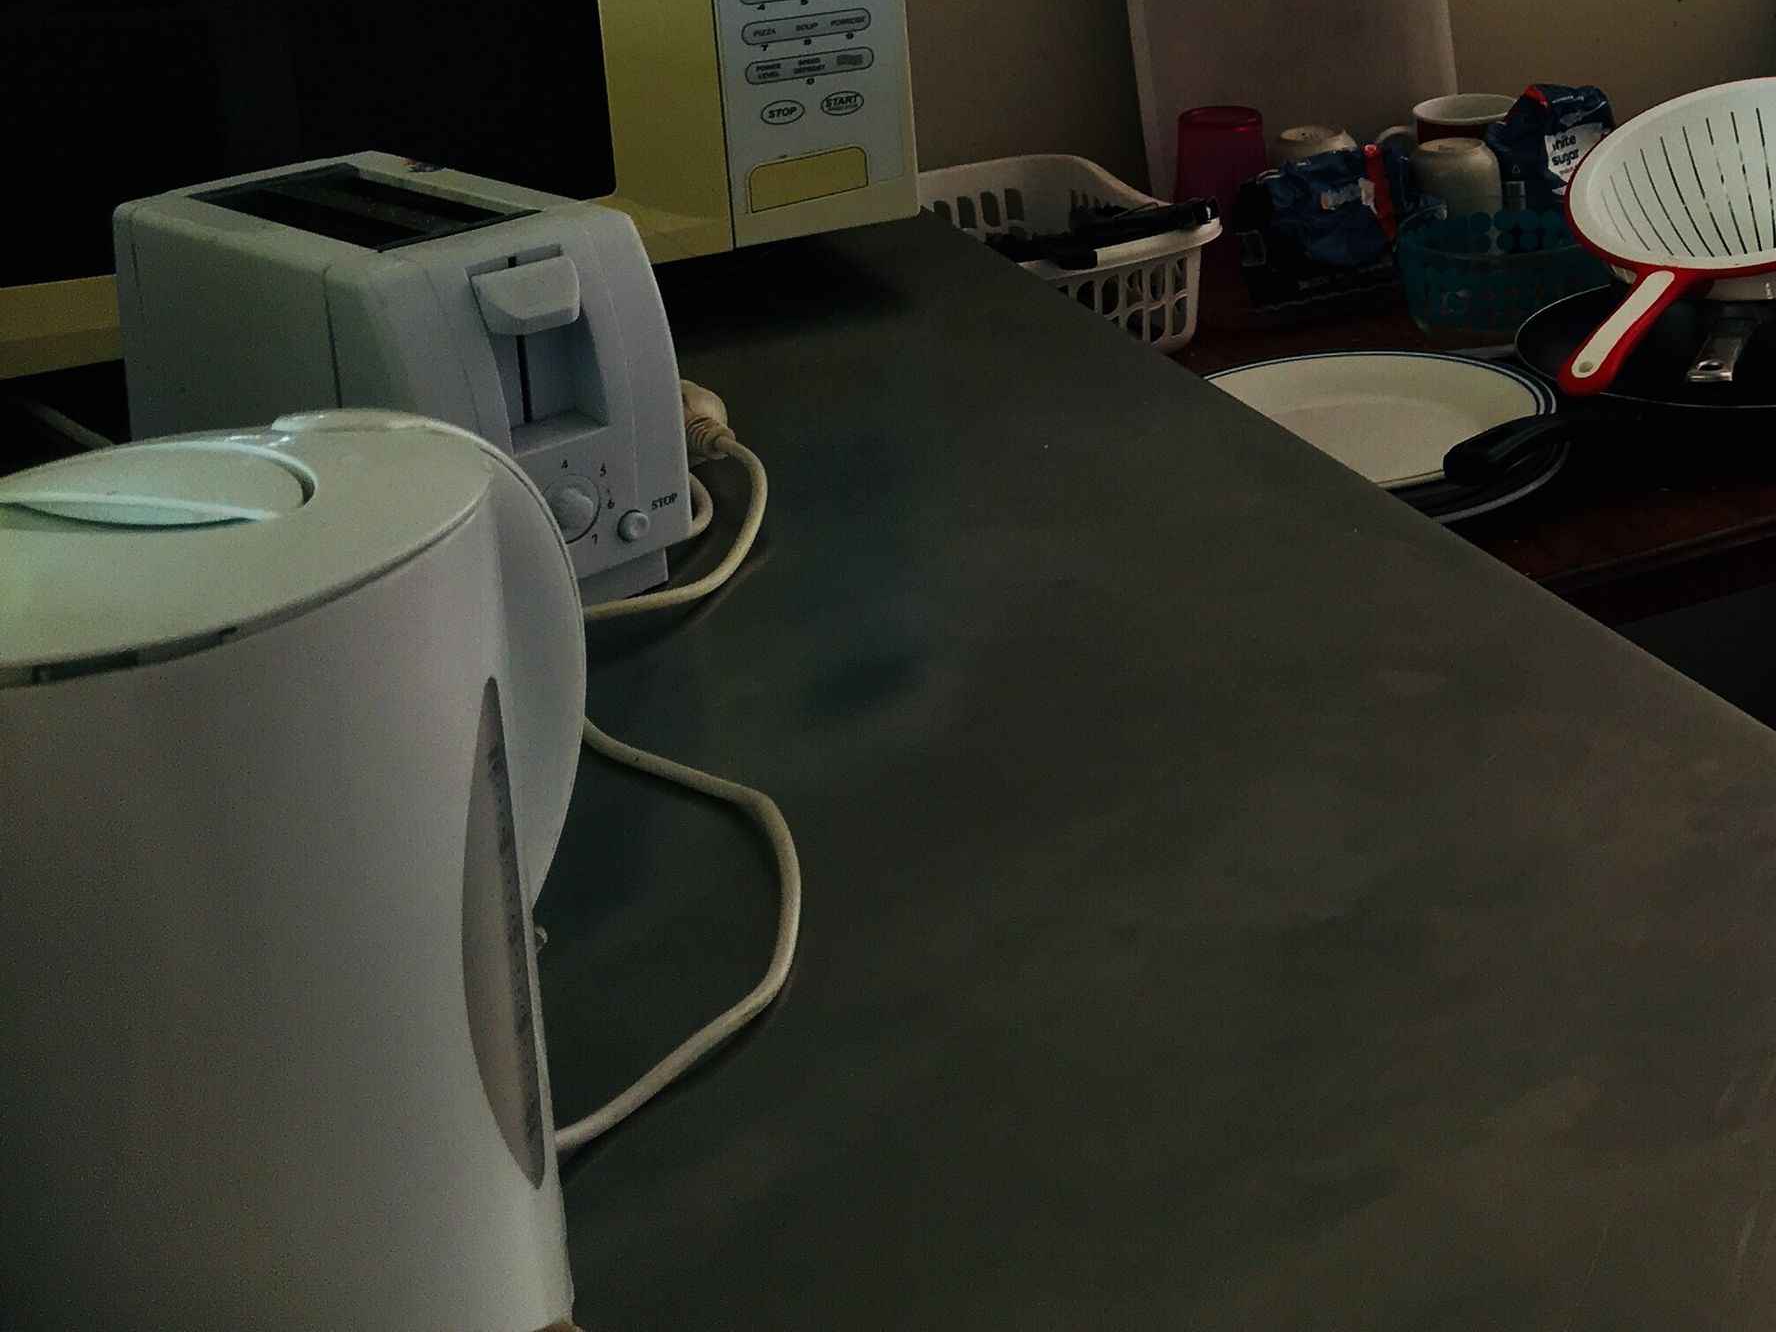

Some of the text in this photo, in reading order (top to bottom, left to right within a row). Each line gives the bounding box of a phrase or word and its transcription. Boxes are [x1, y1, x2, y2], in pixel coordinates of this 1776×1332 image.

[825, 94, 859, 107] START
[768, 106, 798, 119] STOP
[1552, 149, 1579, 166] sugar
[607, 498, 615, 509] 6
[651, 493, 679, 510] STOP
[591, 533, 599, 545] 7
